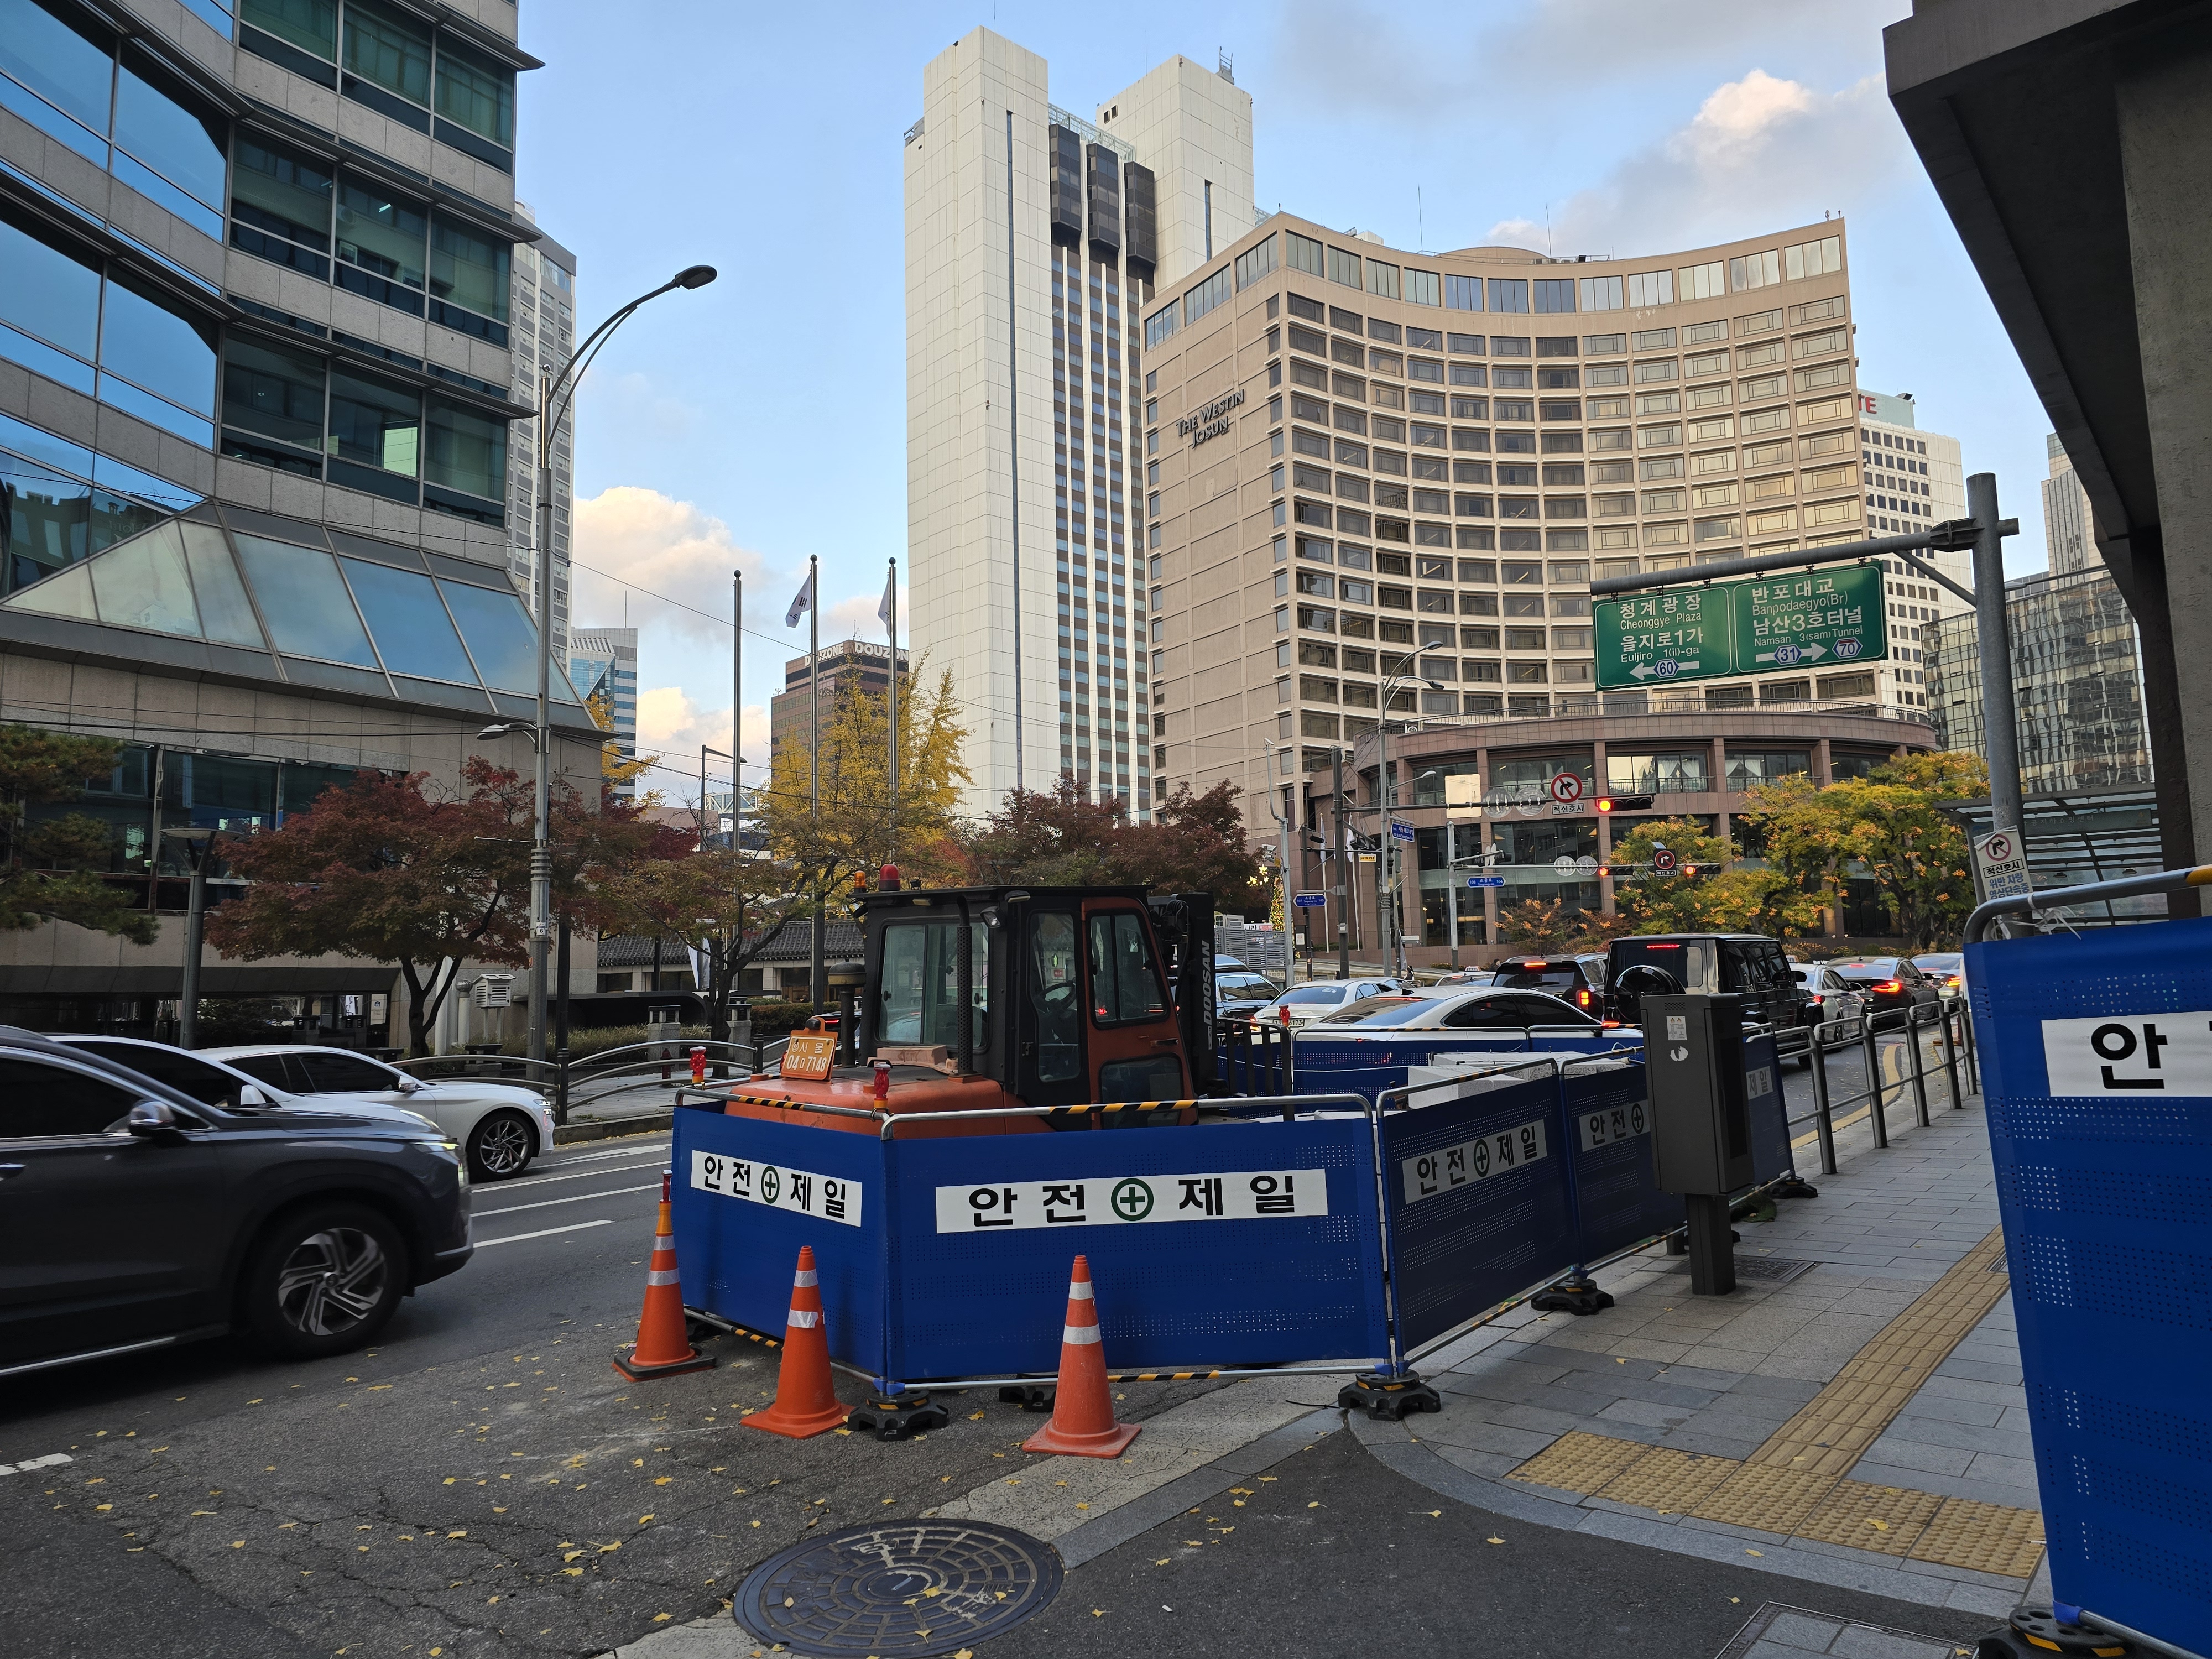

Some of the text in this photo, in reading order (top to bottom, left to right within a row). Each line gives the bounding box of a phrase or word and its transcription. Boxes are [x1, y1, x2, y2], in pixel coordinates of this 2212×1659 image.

[1176, 389, 1244, 437] THE WESTIN
[1192, 416, 1229, 449] JOSUN
[1752, 578, 1834, 604] 반포대교
[1752, 591, 1848, 616] Banpodaegyo(Br)
[1620, 593, 1701, 619] 청계광장
[1620, 612, 1702, 630] Cheonggye Plaza
[1754, 606, 1862, 636] 남산3호터널
[1620, 627, 1703, 652] 을지로1가
[1754, 625, 1863, 646] Namsan 3(sam) Tunnel
[805, 643, 844, 666] DUZONE
[1621, 647, 1700, 663] Euljiro 1(il)-ga
[1780, 648, 1796, 661] 31
[1839, 643, 1855, 655] 70
[1659, 662, 1673, 675] 60
[1553, 805, 1583, 813] 적신호시
[1986, 861, 2020, 874] 적신호시
[1989, 872, 2023, 889] 위반 차량
[1202, 940, 1212, 1025] DOOSAN
[799, 1041, 824, 1055] 서울
[1748, 1070, 1768, 1095] 제일
[1589, 1110, 1627, 1145] 안전
[1417, 1126, 1538, 1196] 안전 제일
[704, 1156, 846, 1219] 안전 제일
[968, 1175, 1295, 1227] 안전 제일
